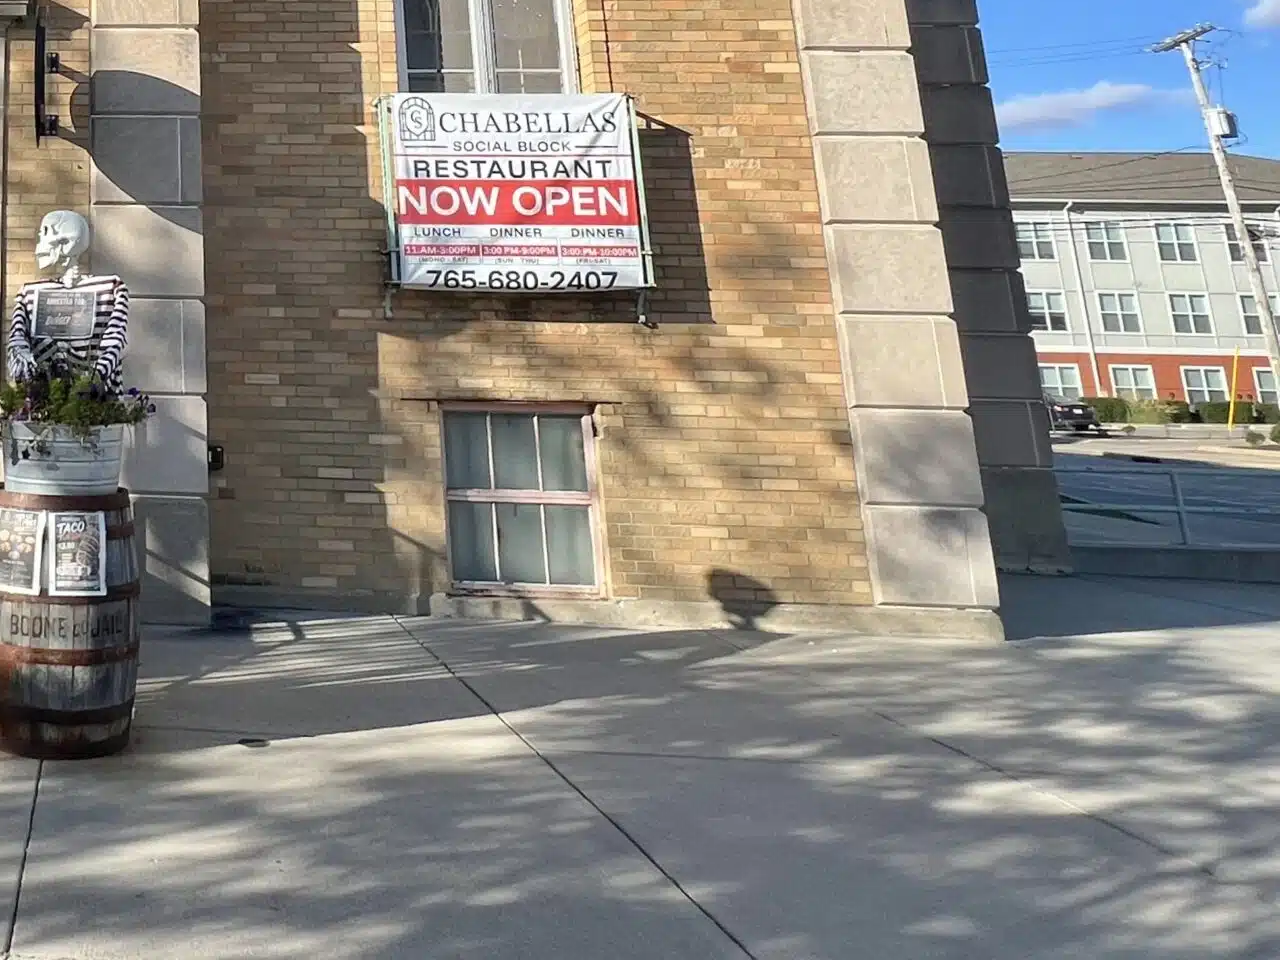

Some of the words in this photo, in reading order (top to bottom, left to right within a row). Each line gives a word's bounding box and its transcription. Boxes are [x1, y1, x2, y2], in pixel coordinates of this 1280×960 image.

[438, 112, 617, 134] CHABELLAS
[452, 140, 513, 153] SOCIAL
[518, 140, 571, 153] BLOCK
[414, 159, 612, 179] RESTAURANT
[399, 186, 500, 217] NOW
[511, 186, 629, 217] OPEN
[413, 227, 461, 238] LUNCH
[489, 227, 542, 238] DINNER
[570, 227, 625, 238] DINNER
[425, 269, 618, 290] 765-680-2407
[56, 521, 85, 533] TACO
[10, 614, 68, 638] BOONE
